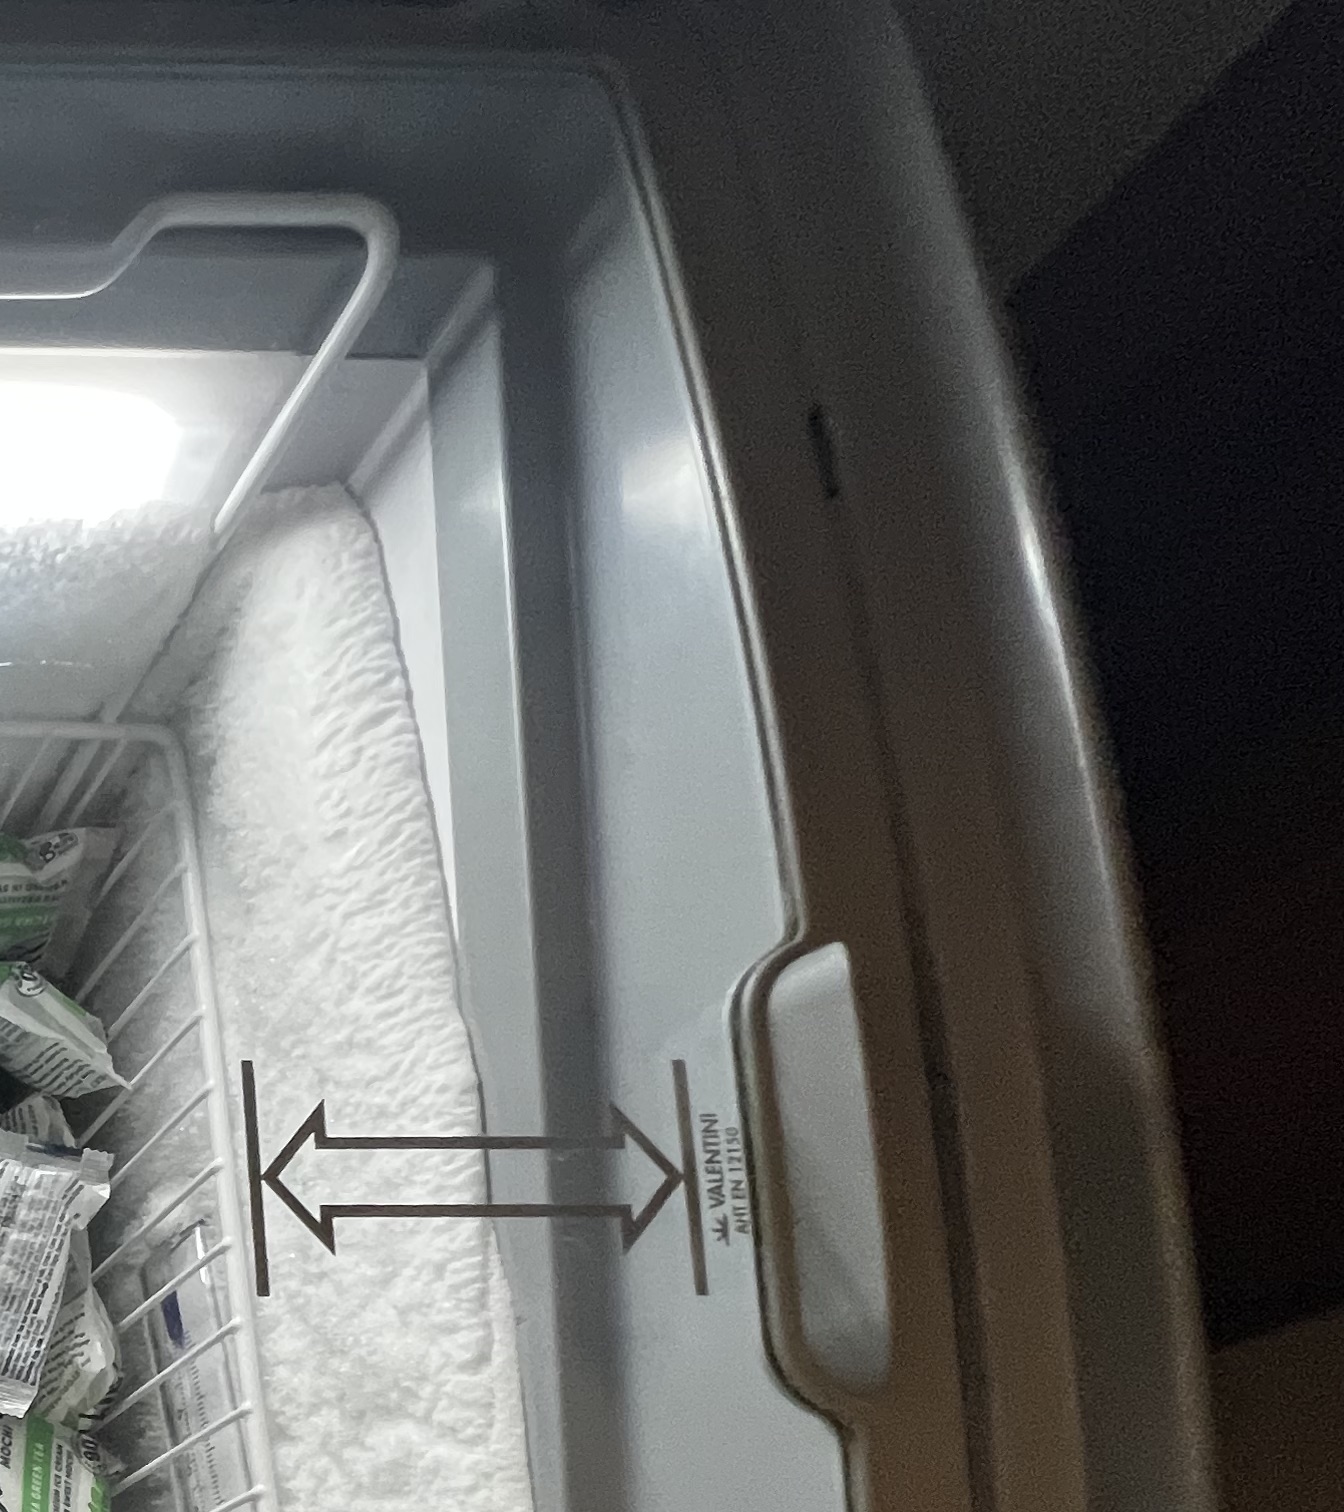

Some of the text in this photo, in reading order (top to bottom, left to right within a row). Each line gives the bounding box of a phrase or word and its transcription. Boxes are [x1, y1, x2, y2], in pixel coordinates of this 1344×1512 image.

[699, 1113, 725, 1210] VALENTINI
[730, 1180, 747, 1202] EN
[733, 1205, 750, 1235] AHT
[0, 1425, 13, 1470] MOCHI
[32, 1442, 45, 1462] TEA
[28, 1465, 44, 1500] GREEN
